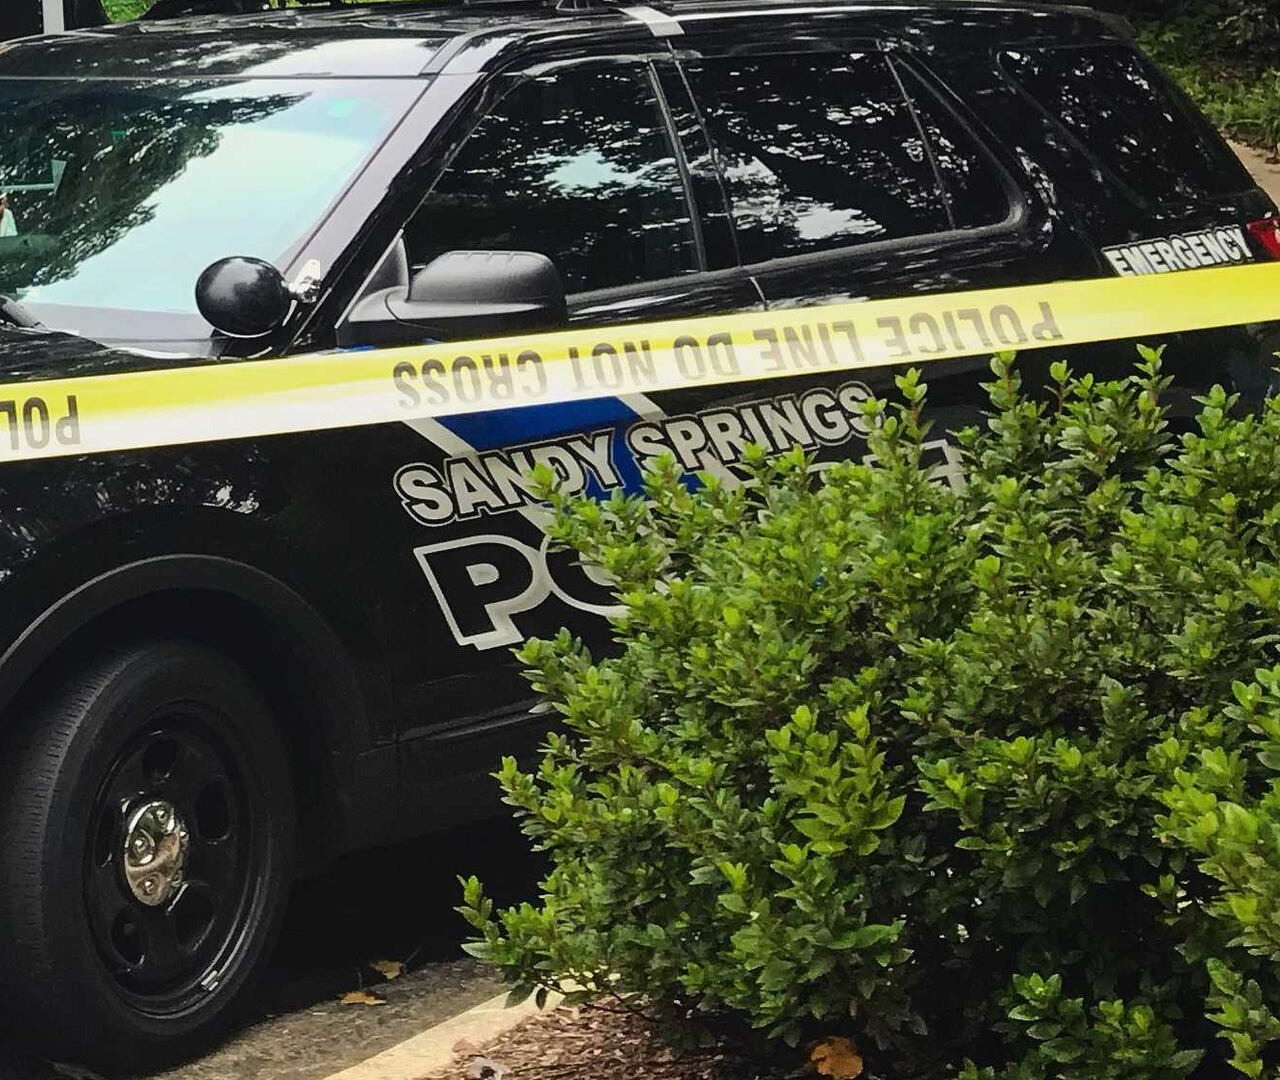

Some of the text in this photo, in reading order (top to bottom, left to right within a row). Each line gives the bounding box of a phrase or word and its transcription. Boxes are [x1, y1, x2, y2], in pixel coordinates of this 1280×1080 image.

[1101, 224, 1254, 277] EMERGENCY
[392, 301, 1064, 410] POLICE LINE DO NOT CROSS
[393, 380, 886, 527] SANDY SPRINGS
